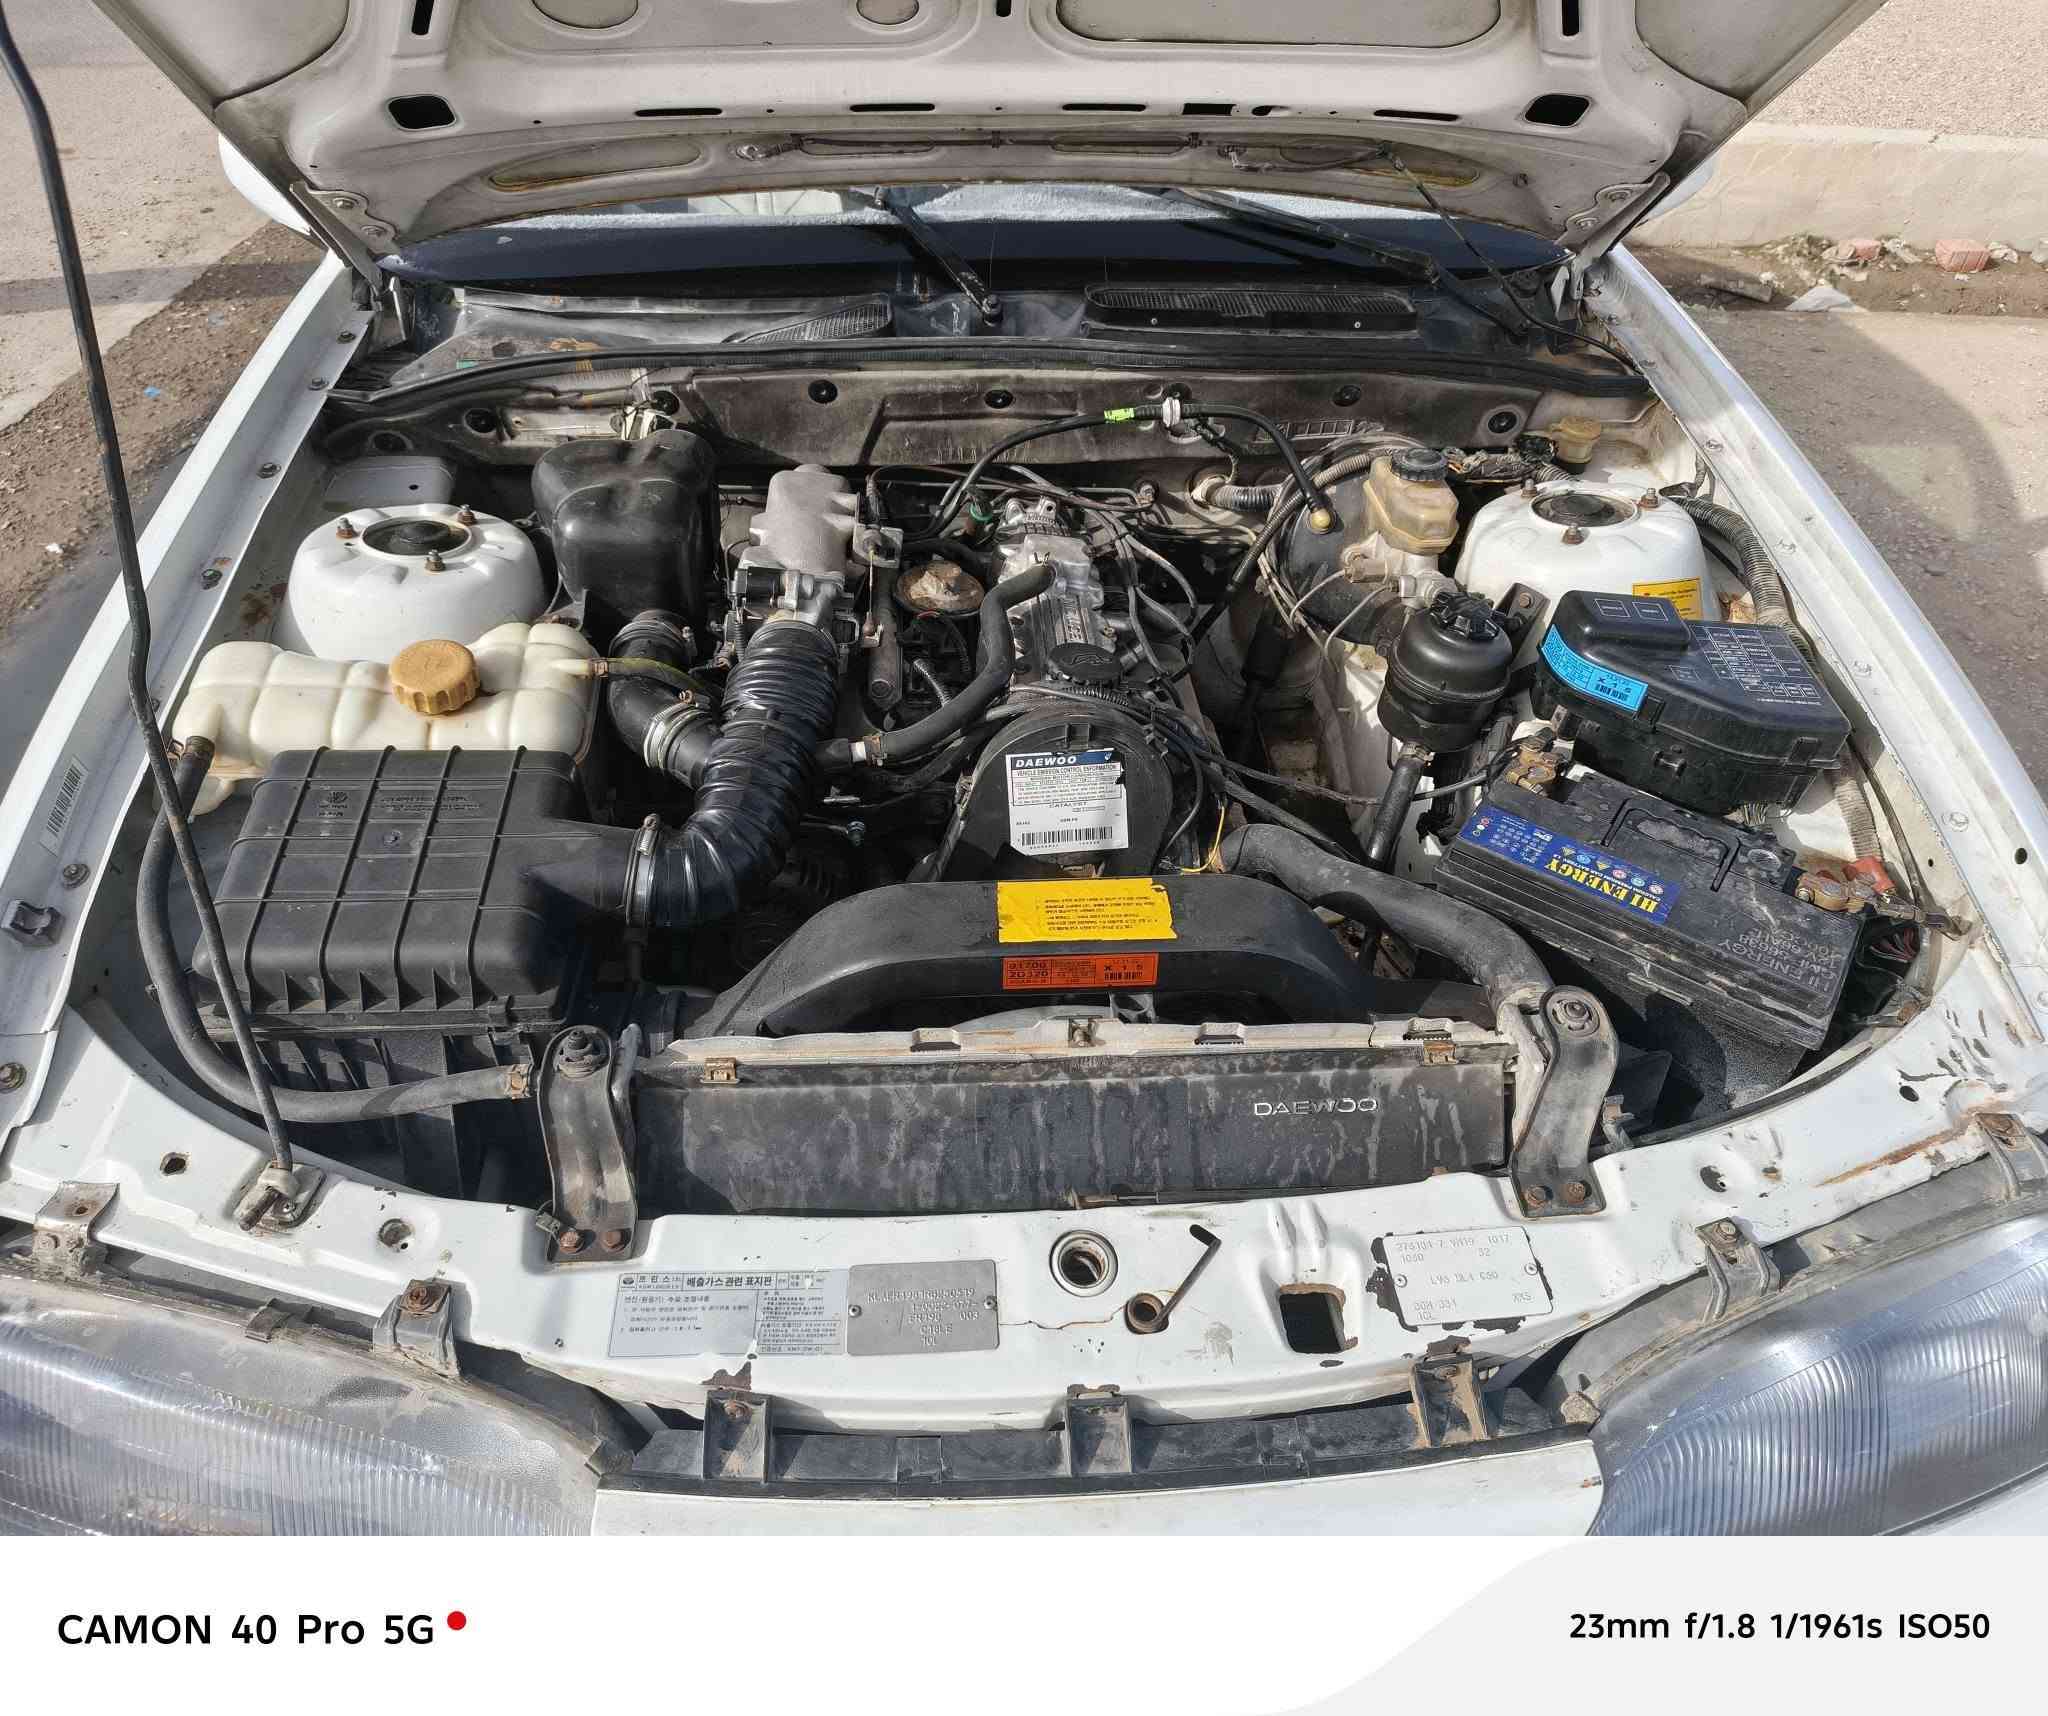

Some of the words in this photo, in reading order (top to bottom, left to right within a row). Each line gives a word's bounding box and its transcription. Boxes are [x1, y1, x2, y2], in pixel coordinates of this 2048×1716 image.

[1015, 755, 1077, 768] DAEWOO
[1544, 857, 1630, 902] ENERGY
[1629, 892, 1659, 914] HI
[1254, 1097, 1378, 1116] DAEWOO
[686, 1275, 723, 1287] 배출가스
[725, 1275, 743, 1287] 관련
[746, 1275, 773, 1287] 표지판
